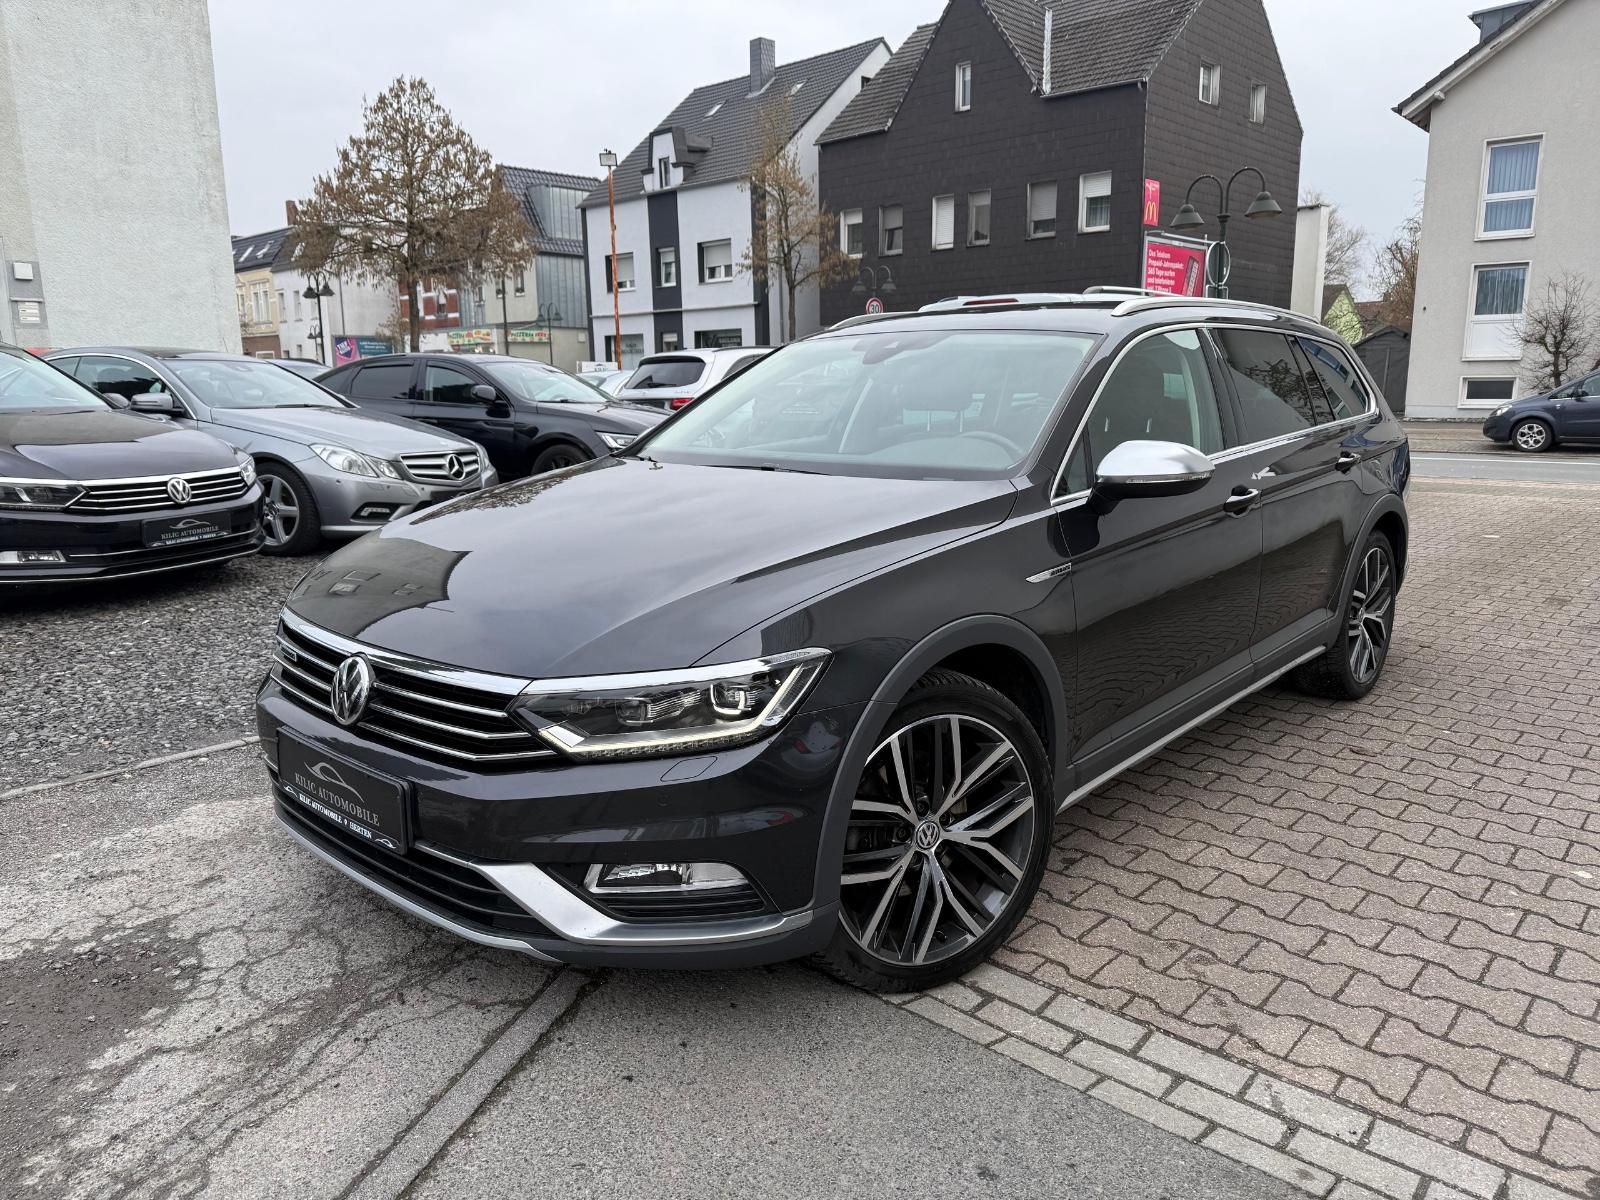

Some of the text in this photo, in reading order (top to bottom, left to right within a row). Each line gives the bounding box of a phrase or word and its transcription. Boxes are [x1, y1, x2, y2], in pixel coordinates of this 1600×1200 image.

[1156, 250, 1171, 259] Telekom
[1155, 268, 1163, 277] Tage
[870, 304, 880, 313] 30
[180, 526, 218, 537] AUTOMOBILE
[294, 772, 380, 827] KILIC AUTOMOBILE
[299, 793, 372, 839] KILIC AUTOMOBILE HERTEN
